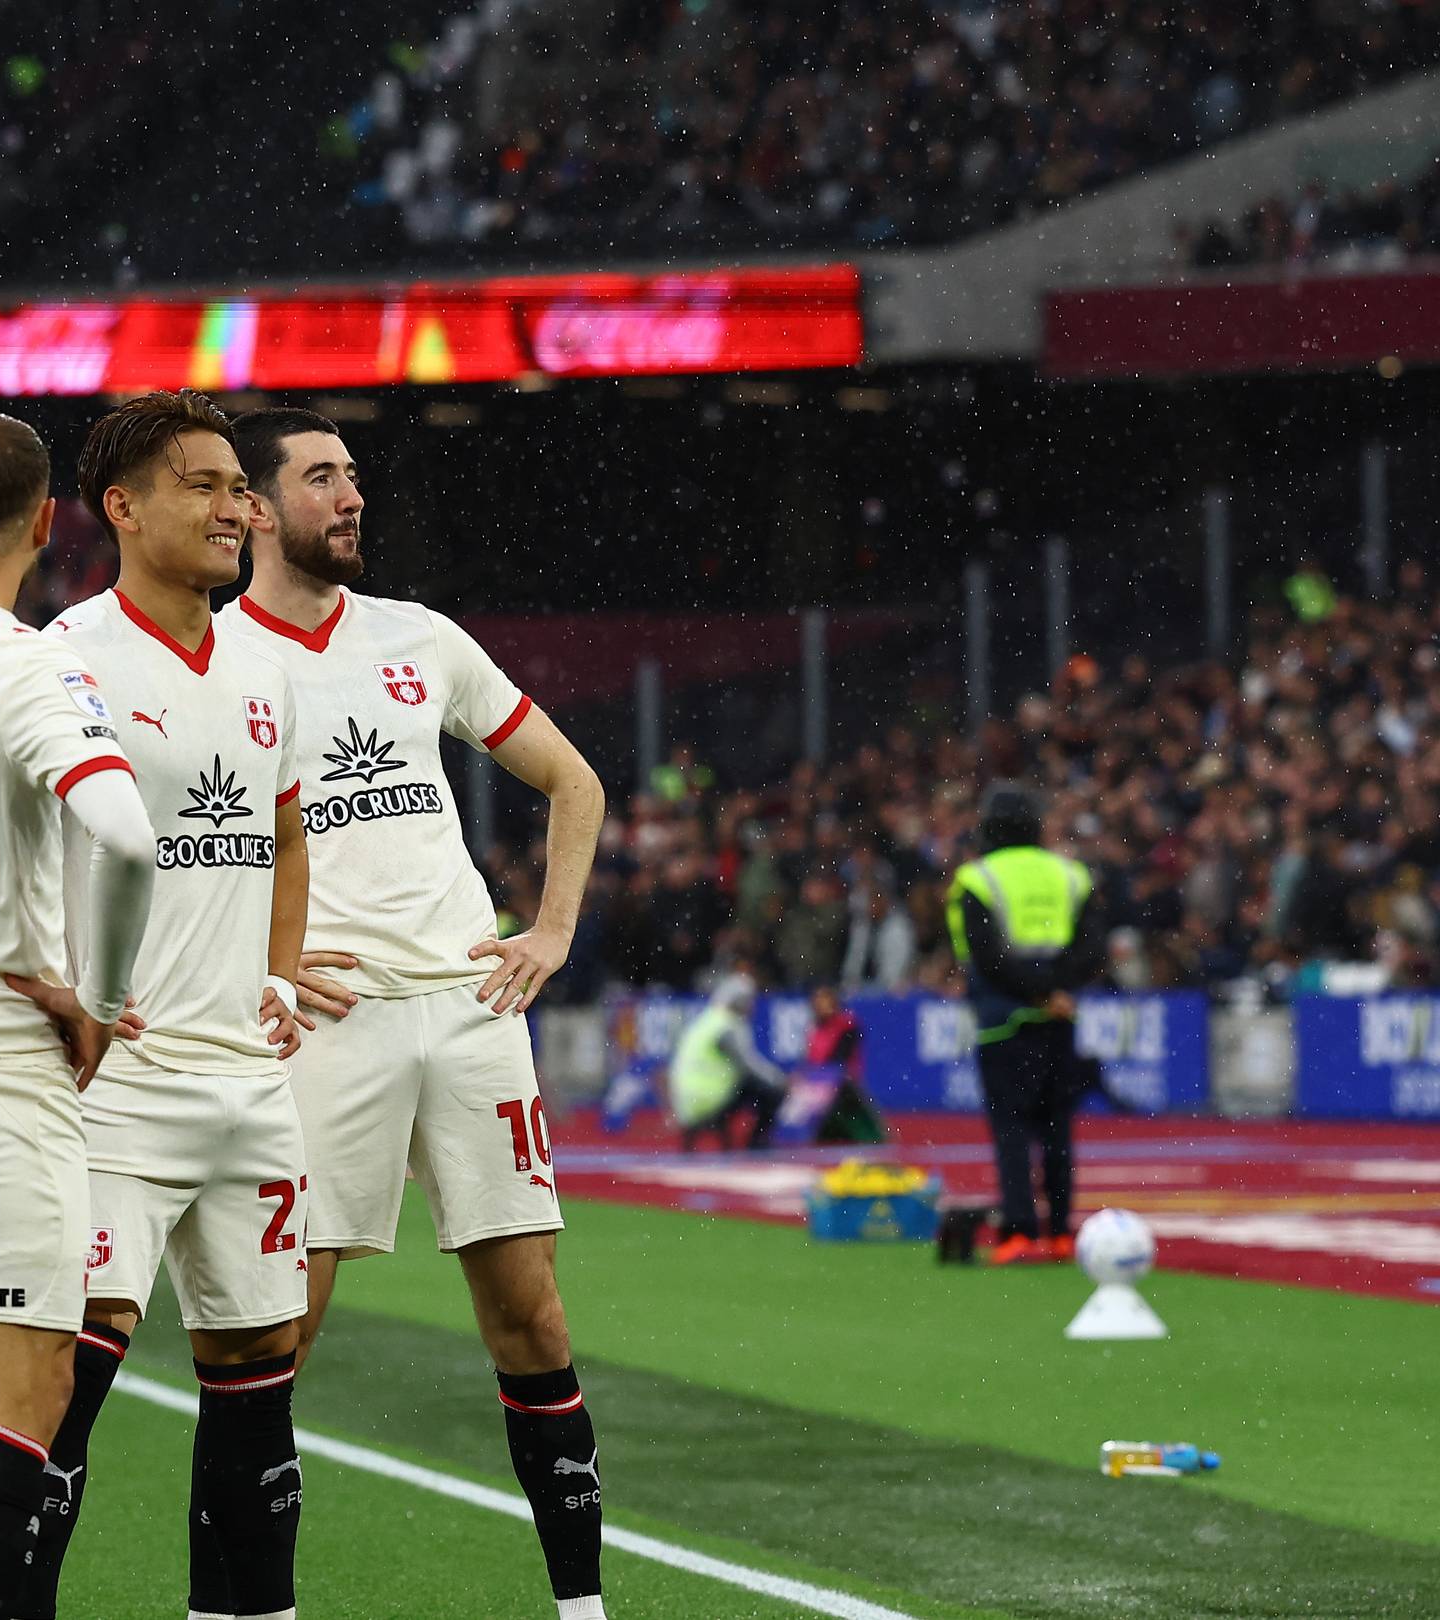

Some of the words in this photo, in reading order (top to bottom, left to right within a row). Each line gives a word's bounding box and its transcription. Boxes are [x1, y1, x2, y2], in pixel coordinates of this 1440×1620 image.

[350, 783, 443, 821] CRUISES
[156, 835, 197, 870] &O
[197, 833, 275, 869] CRUISES
[496, 1095, 551, 1172] 10
[258, 1174, 307, 1255] 2
[565, 1489, 601, 1509] SFC
